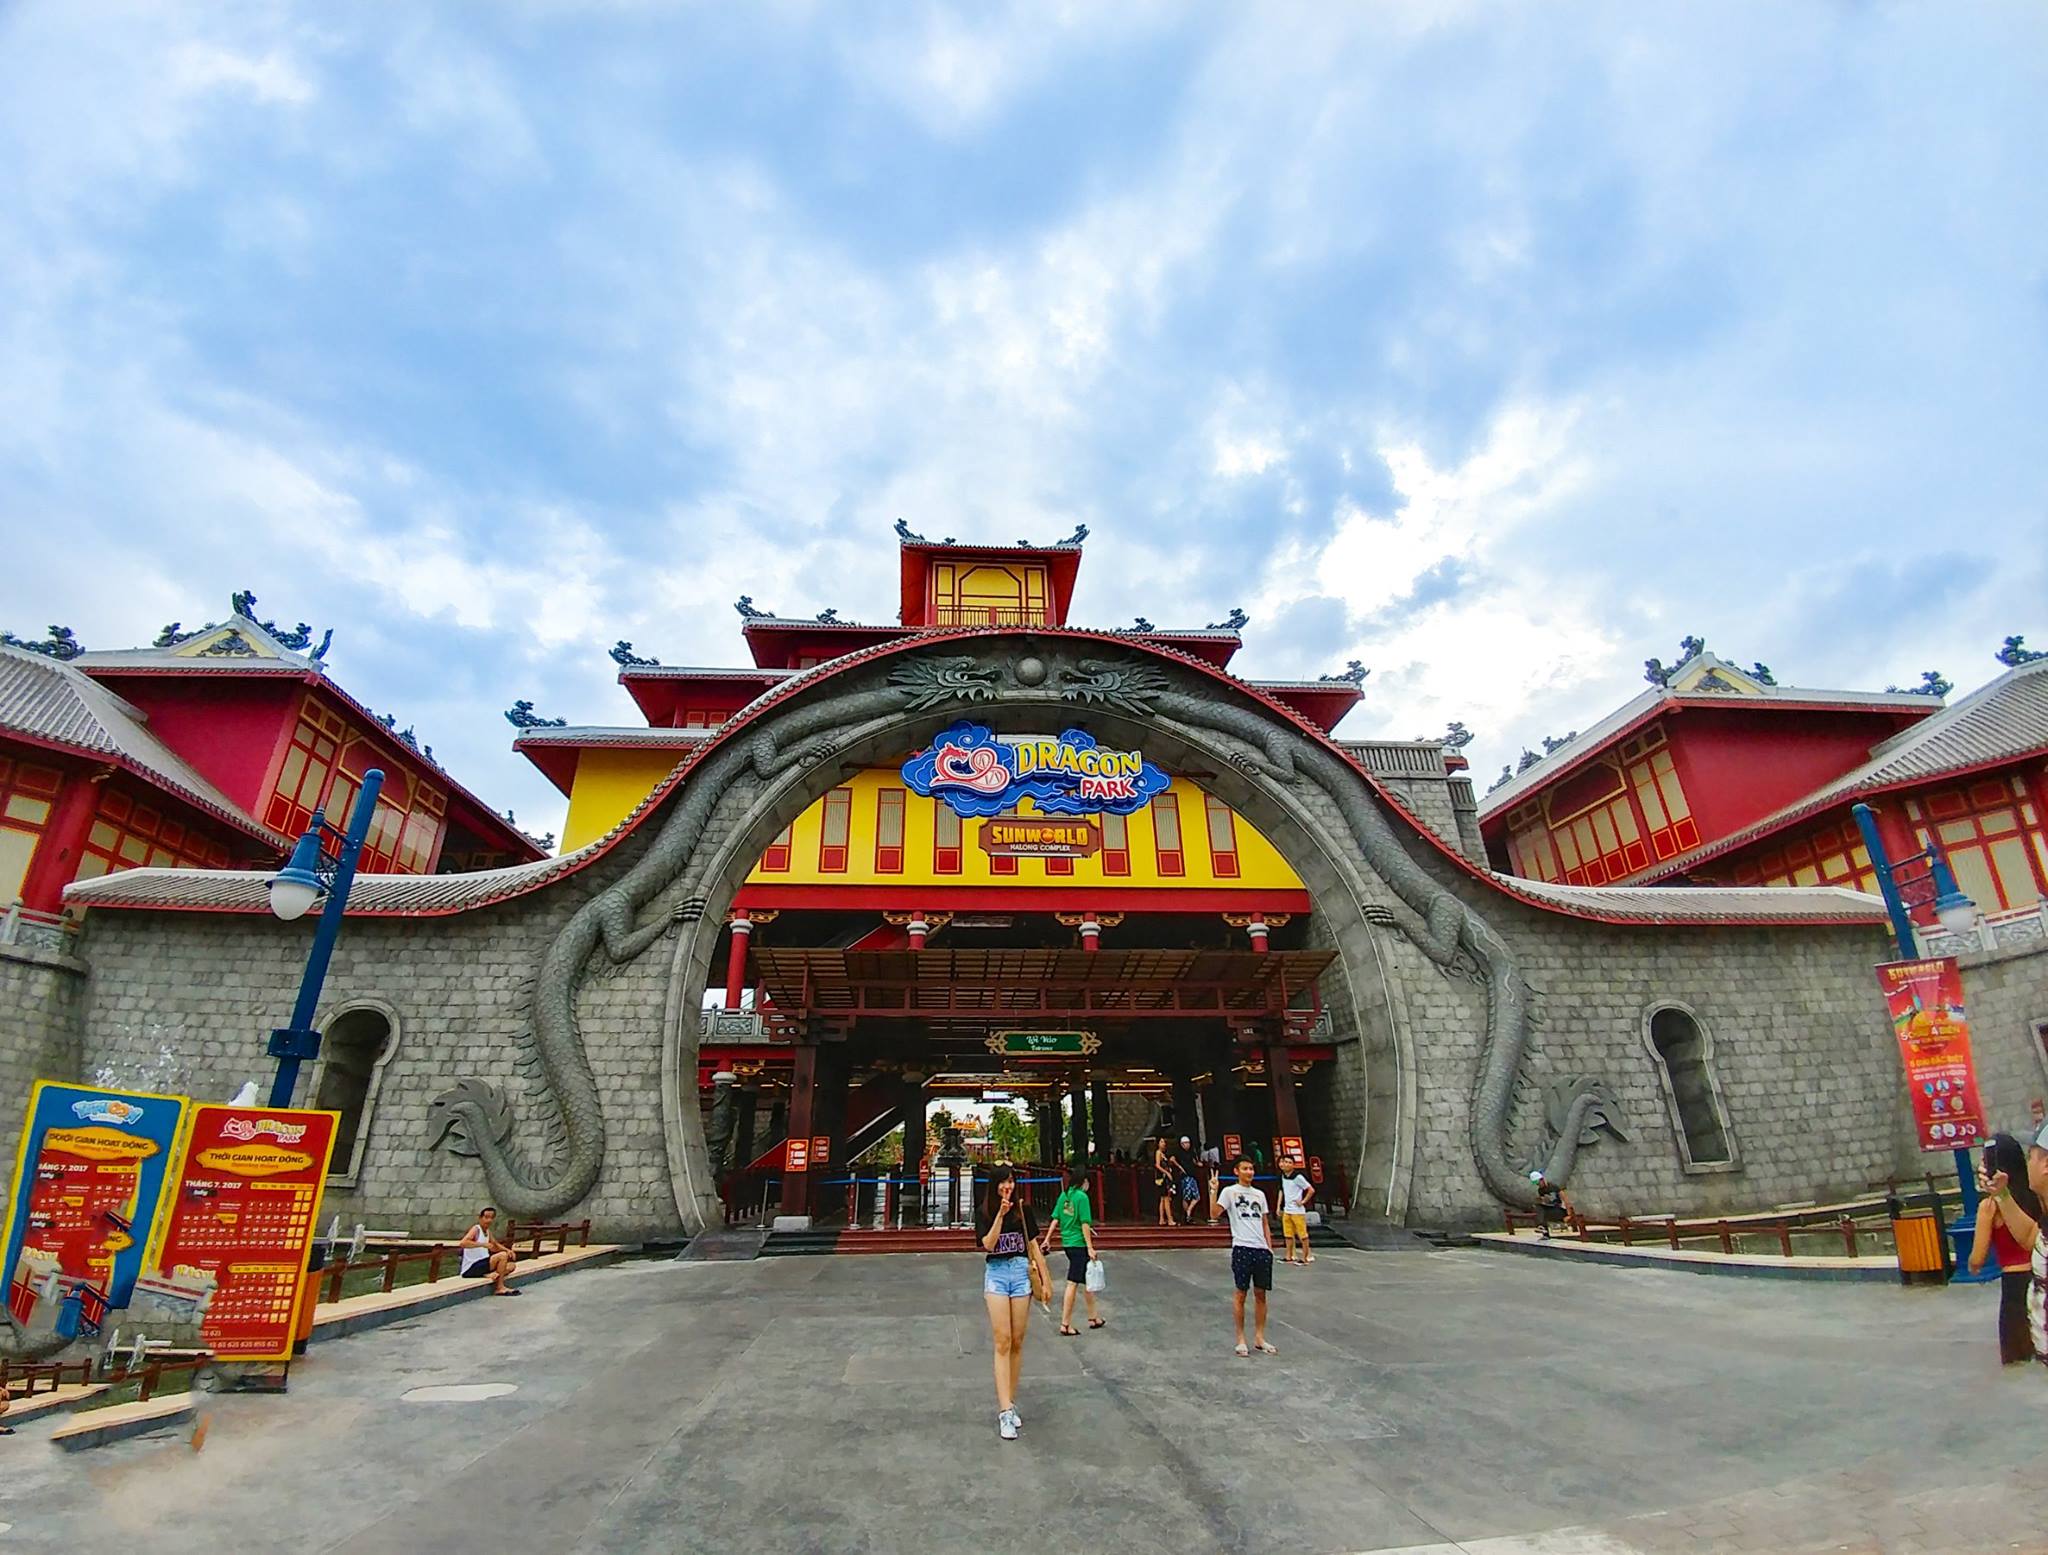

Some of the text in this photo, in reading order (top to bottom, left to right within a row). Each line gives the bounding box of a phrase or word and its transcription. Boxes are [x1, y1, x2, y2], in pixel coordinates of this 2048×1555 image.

[1016, 742, 1141, 778] DRAGON
[1081, 778, 1136, 798] PARK
[992, 826, 1088, 845] SUNWORLD
[277, 1134, 300, 1143] PARK
[68, 1164, 88, 1172] 2017
[222, 1181, 243, 1189] 2017
